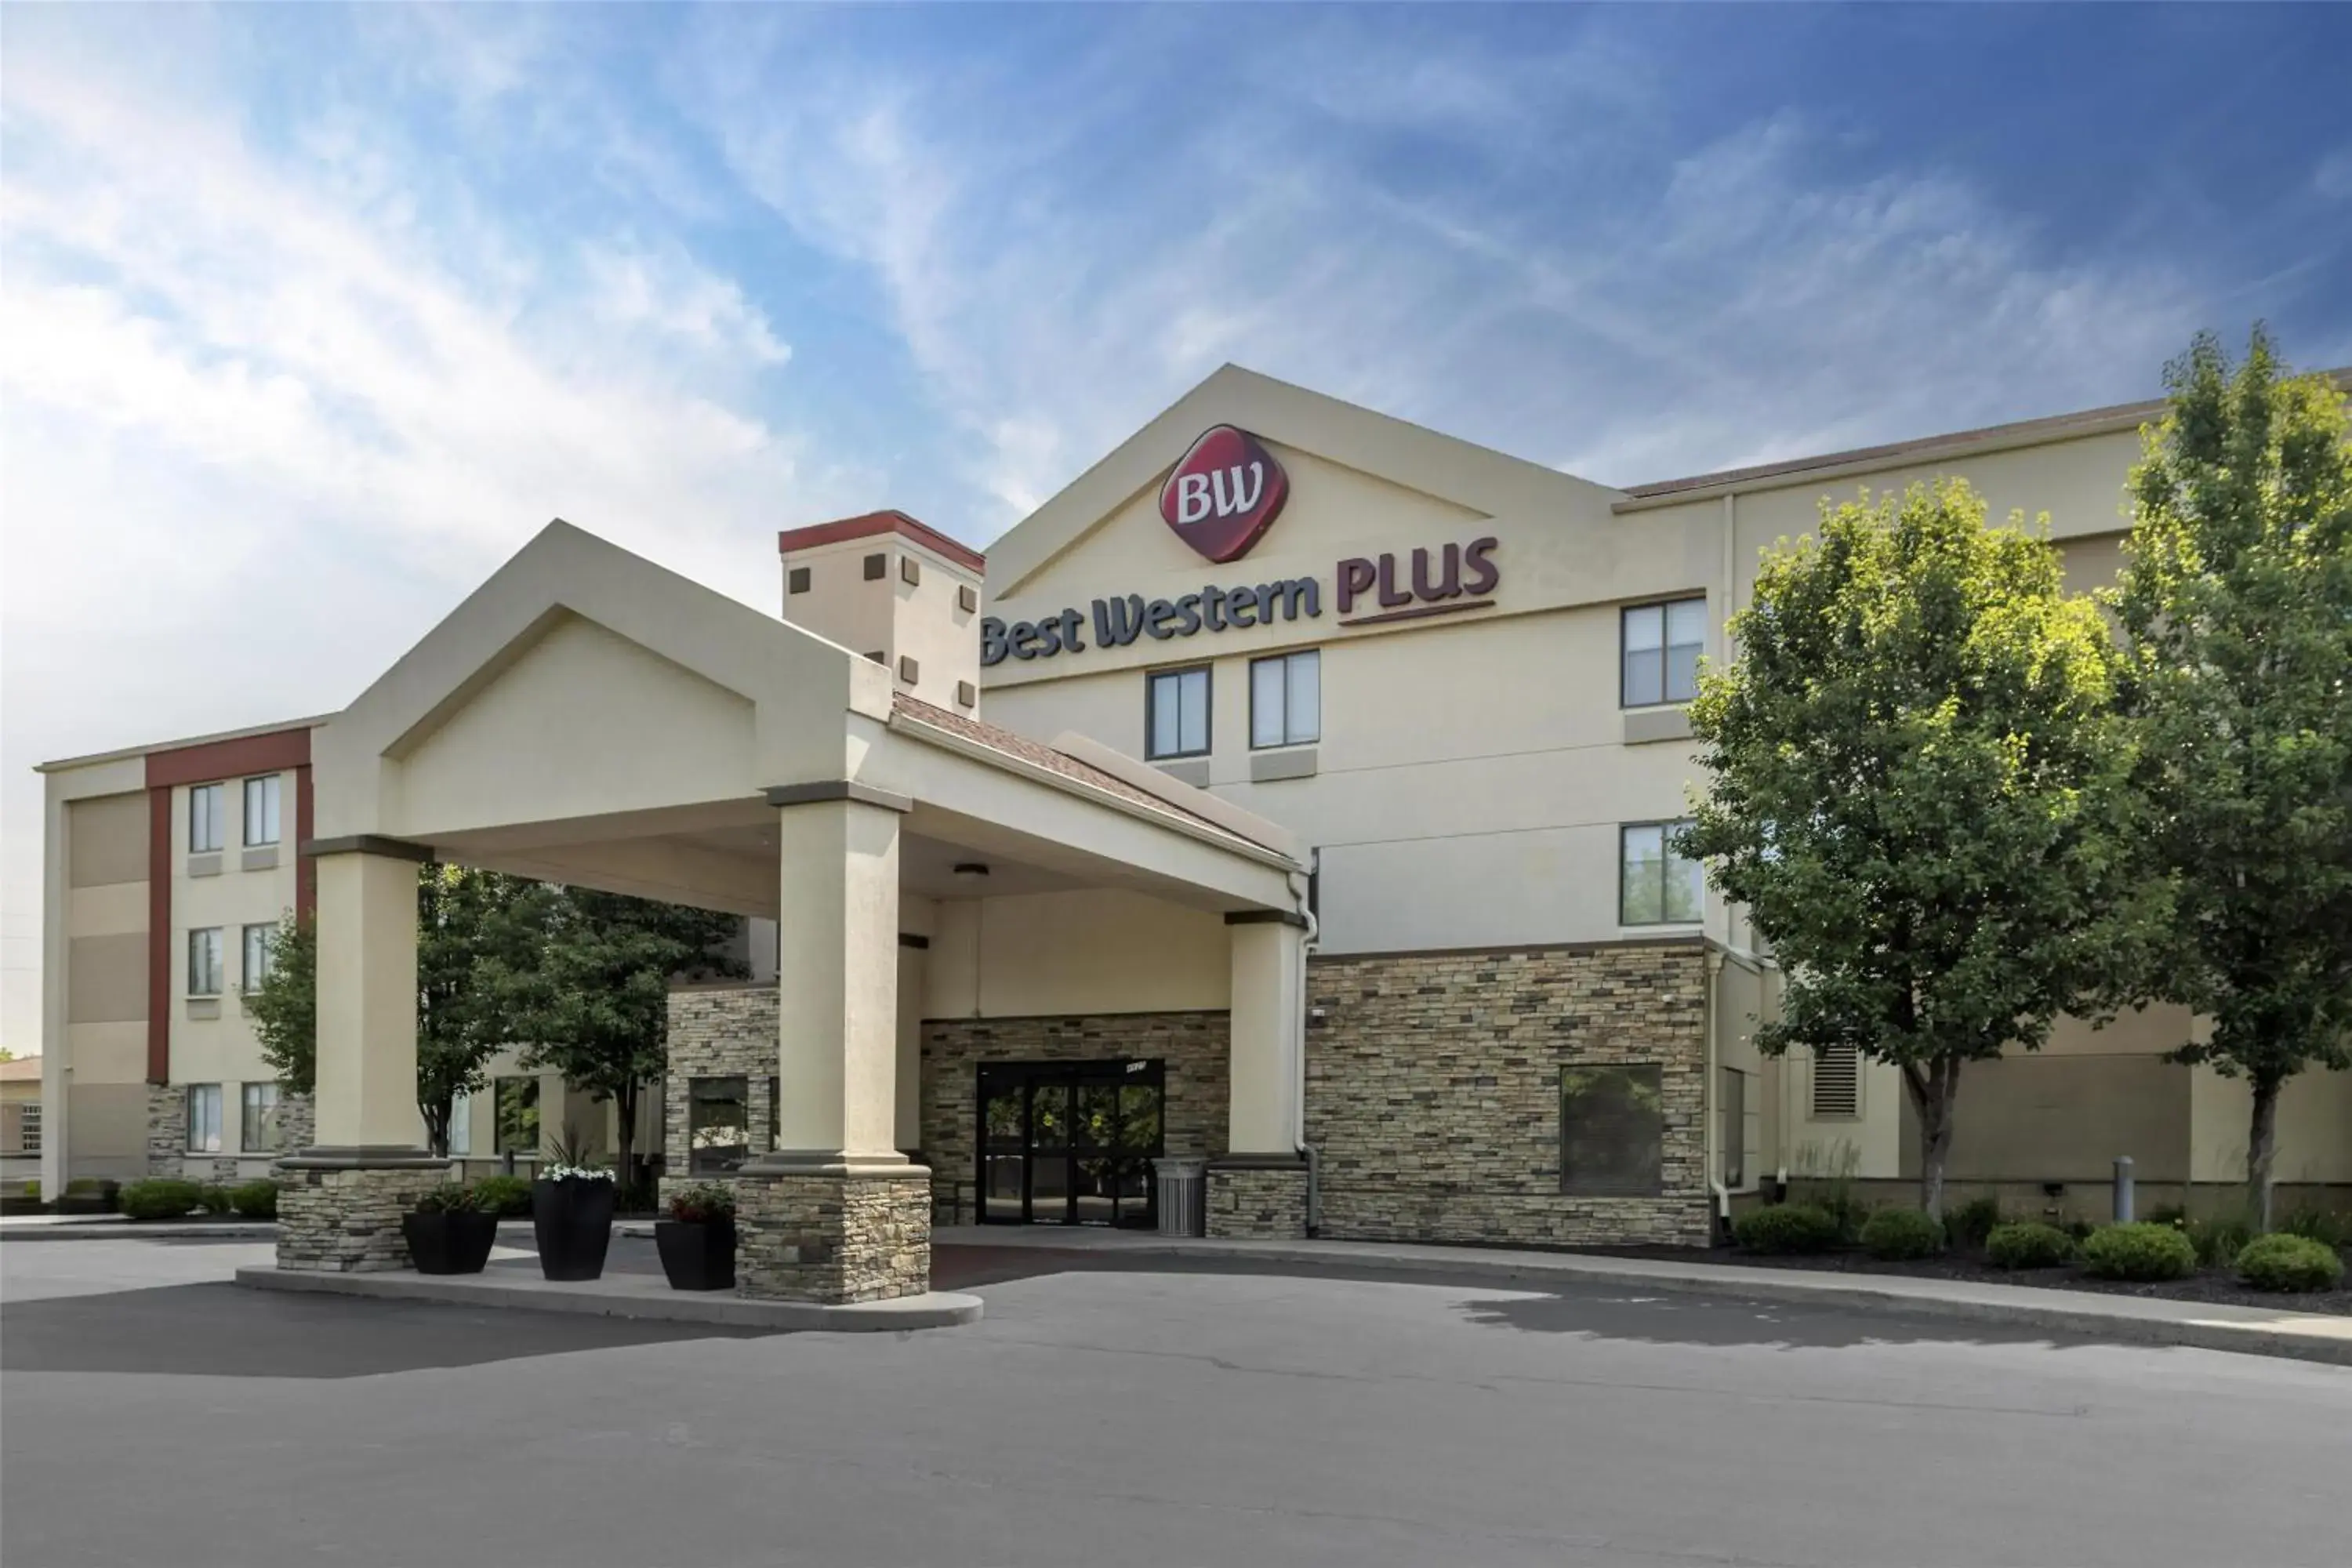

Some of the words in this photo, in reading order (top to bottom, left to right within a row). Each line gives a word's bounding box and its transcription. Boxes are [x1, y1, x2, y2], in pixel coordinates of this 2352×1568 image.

[1178, 461, 1263, 524] BW
[980, 608, 1085, 666] Best
[1091, 576, 1322, 648] Western
[1338, 536, 1499, 613] PLUS
